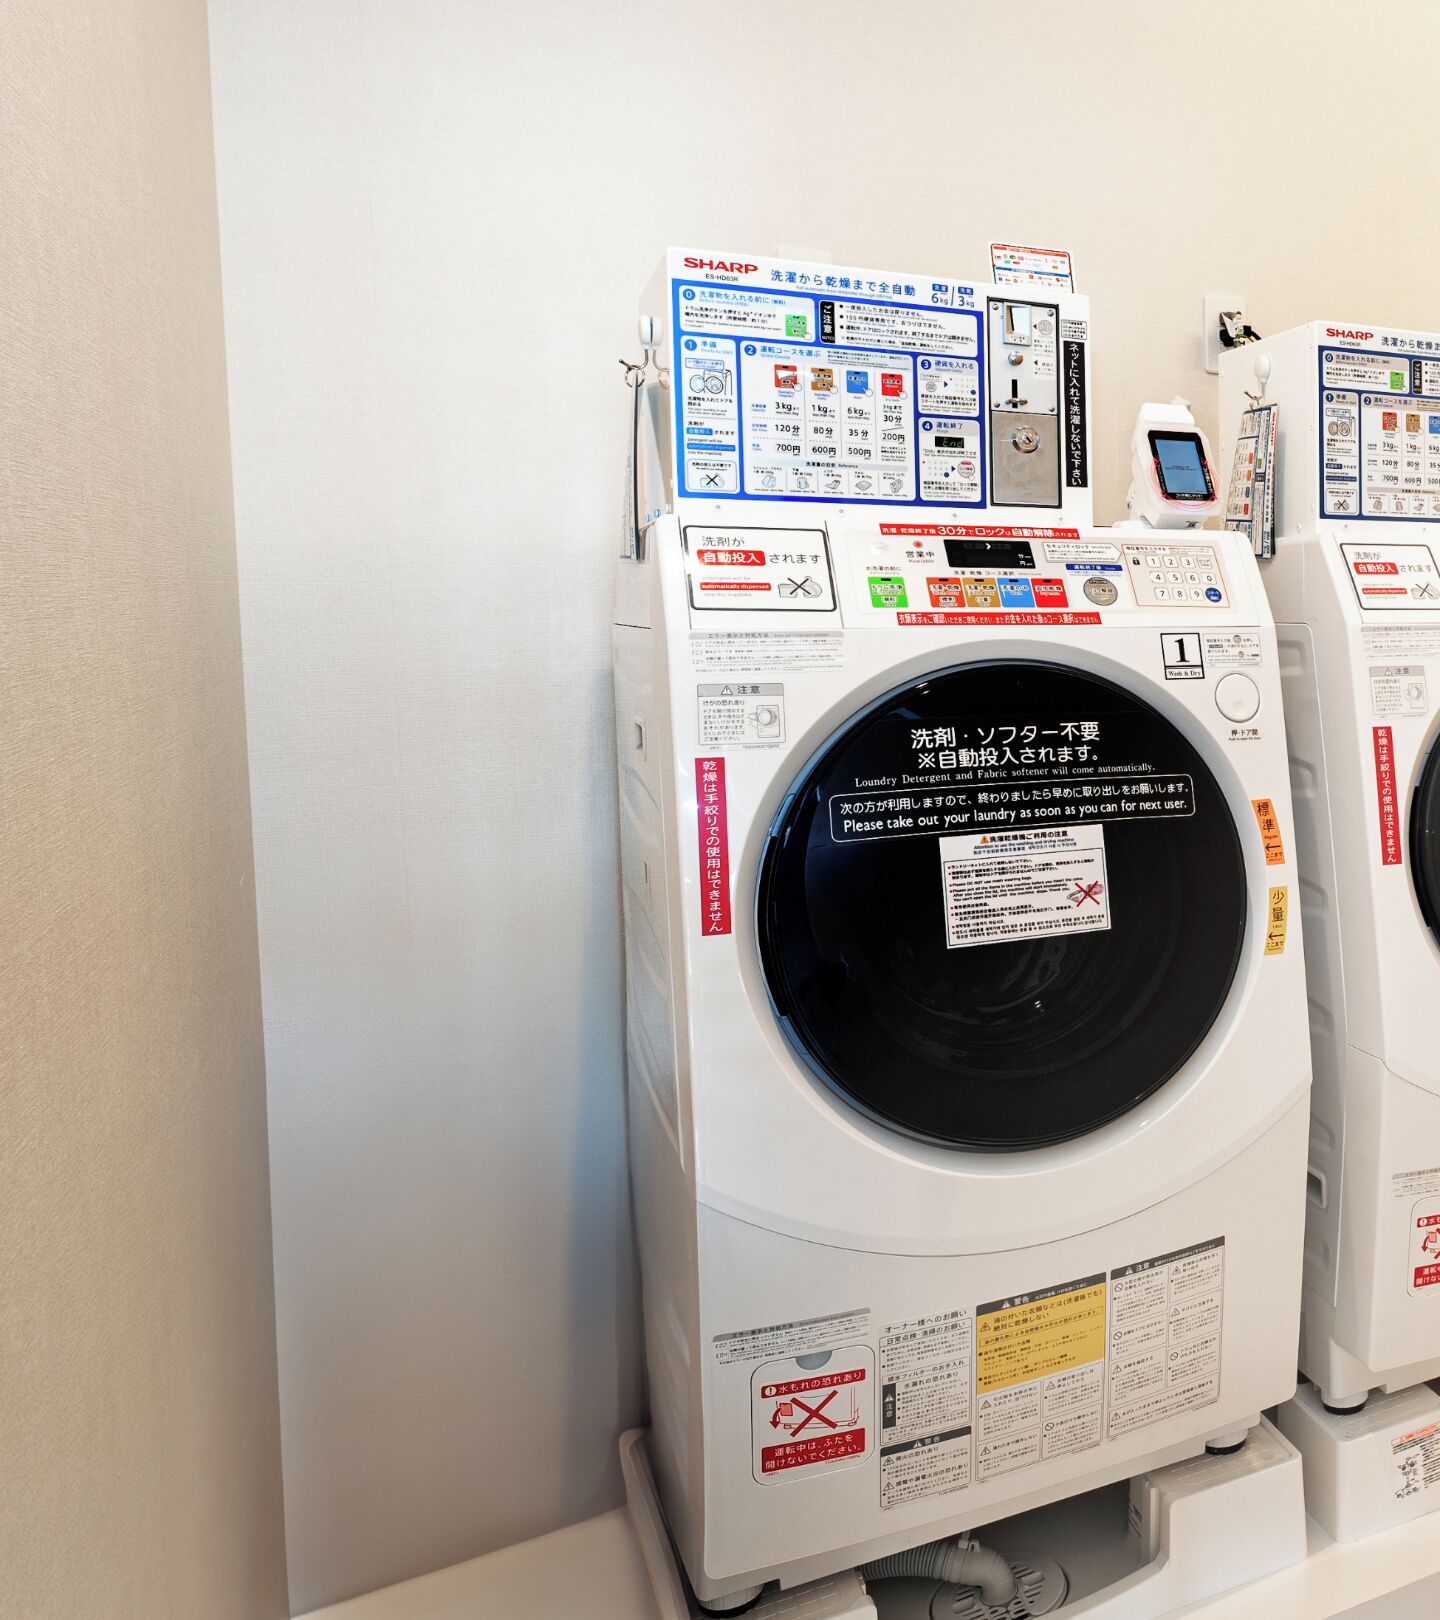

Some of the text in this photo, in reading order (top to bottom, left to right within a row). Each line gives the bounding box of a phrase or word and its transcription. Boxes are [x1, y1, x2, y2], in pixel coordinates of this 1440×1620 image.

[683, 257, 759, 274] SHARP
[770, 268, 916, 297] 洗濯から乾燥まで全自動
[822, 303, 835, 334] ご注意
[1326, 328, 1374, 341] SHARP
[700, 340, 717, 349] 準備
[760, 345, 821, 358] 運転コースを選ぶ
[934, 360, 974, 370] 硬貨を入れる
[883, 414, 902, 424] 30分
[1069, 343, 1082, 486] ネットに入れて洗濯しないで下さい
[775, 424, 800, 434] 120分
[813, 426, 833, 436] 80分
[936, 421, 963, 430] 運転終了
[848, 428, 869, 438] 35分
[882, 433, 905, 443] 200円
[776, 443, 801, 454] 700円
[942, 437, 964, 448] End
[812, 446, 837, 456] 600円
[848, 447, 872, 458] 500円
[702, 536, 745, 547] 洗剤が
[703, 552, 821, 564] 自動投入 されます
[905, 550, 935, 559] 営業中
[1353, 551, 1381, 561] 洗剤が
[1358, 564, 1432, 573] 自動投入 されます
[1174, 637, 1190, 663] 1
[1395, 667, 1410, 675] 注意
[737, 685, 761, 695] 注意
[911, 721, 1100, 749] 洗剤・ソフター不要
[918, 744, 1099, 770] ※自動投入されます。
[855, 763, 1156, 788] Loundry Detergent and Fabric softener will come automatically.
[840, 781, 1189, 815] 次の方が利用しますので、終わりましたら早めに取り出しをお願いします。
[1377, 728, 1396, 863] 乾燥は手絞りでの使用はできません
[844, 799, 1187, 833] Please take out your laundry as soon as you can for next user.
[1257, 802, 1275, 833] 標準
[989, 830, 1068, 843] 洗濯乾燥機ご利用の注意
[703, 760, 723, 932] 乾燥は手絞りでの使用はできません
[1272, 890, 1285, 922] 少量
[1135, 1261, 1150, 1272] 注意
[1013, 1295, 1030, 1306] 警告
[885, 1309, 968, 1334] オーナー様へのお願い
[993, 1311, 1050, 1332] 絶対に乾燥しない
[886, 1320, 966, 1346] 日常点検・清掃のお願い
[887, 1359, 965, 1383] 排水フィルターのお手入れ
[778, 1371, 862, 1395] 水もれの恐れあり
[903, 1370, 959, 1389] 水漏れの恐れあり
[884, 1402, 893, 1418] 注意
[774, 1434, 854, 1458] 運転中は、ふたを
[923, 1435, 942, 1447] 警告
[765, 1444, 862, 1469] 開けないでください。
[895, 1445, 940, 1462] 発火の恐れあり
[895, 1462, 969, 1488] 感電や漏電火災の恐れあり
